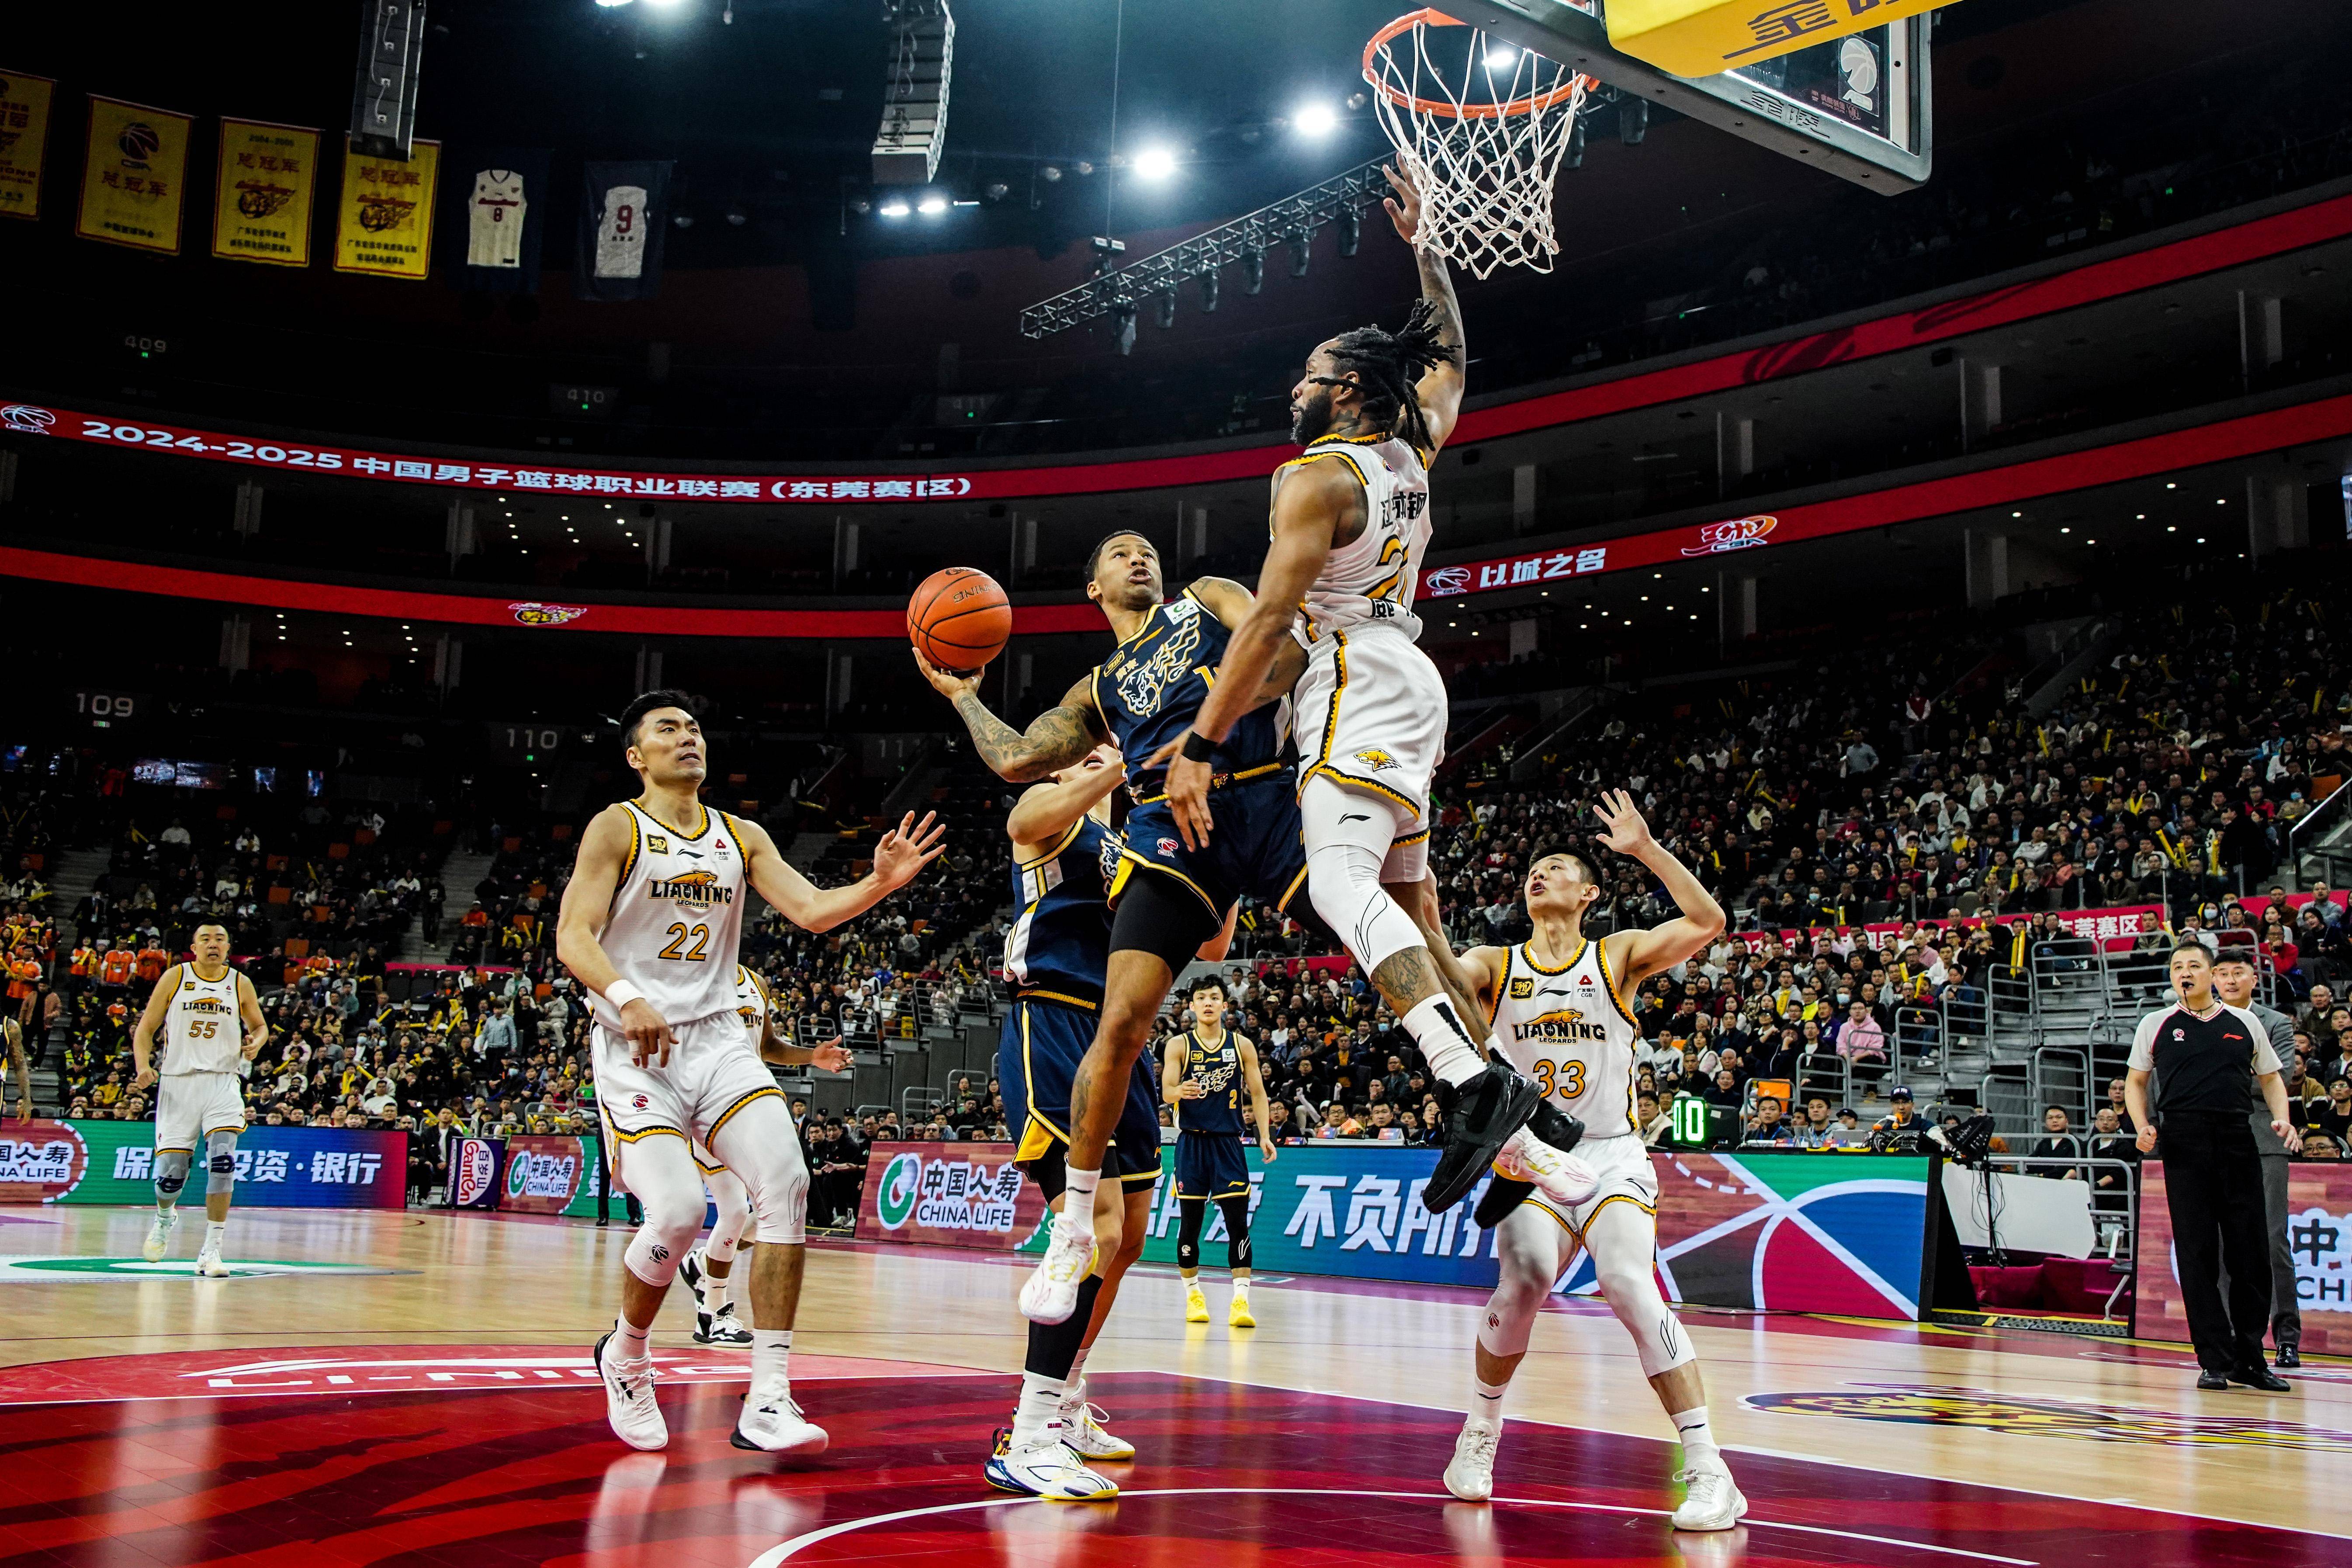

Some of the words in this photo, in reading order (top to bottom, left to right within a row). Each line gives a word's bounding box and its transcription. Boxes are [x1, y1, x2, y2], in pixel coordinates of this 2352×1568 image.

[494, 208, 502, 222] 8
[616, 204, 632, 233] 9
[125, 336, 166, 353] 409
[83, 421, 343, 470] 2024-2025
[1479, 548, 1606, 588] 以城之名
[76, 692, 134, 718] 109
[507, 728, 558, 750] 110
[878, 739, 920, 758] 11
[650, 880, 733, 904] LIAONING
[677, 899, 710, 907] LEOPARDS
[658, 921, 710, 962] 22
[183, 1003, 232, 1016] LIAONING
[189, 1021, 219, 1038] 55
[1513, 1023, 1607, 1043] LIAONING
[1532, 1058, 1587, 1100] 33
[1229, 1089, 1237, 1109] 2
[0, 1145, 69, 1164] 国人寿
[27, 1168, 66, 1178] LIFE
[477, 1150, 490, 1189] 百岁山
[531, 1157, 573, 1179] 中国人寿
[527, 1181, 550, 1192] CHINA
[551, 1183, 568, 1194] LIFE
[925, 1164, 1021, 1202] 中国人寿
[919, 1204, 970, 1225] CHINA
[974, 1207, 1012, 1227] LIFE
[2292, 1218, 2352, 1267] 中
[2295, 1276, 2352, 1301] CH
